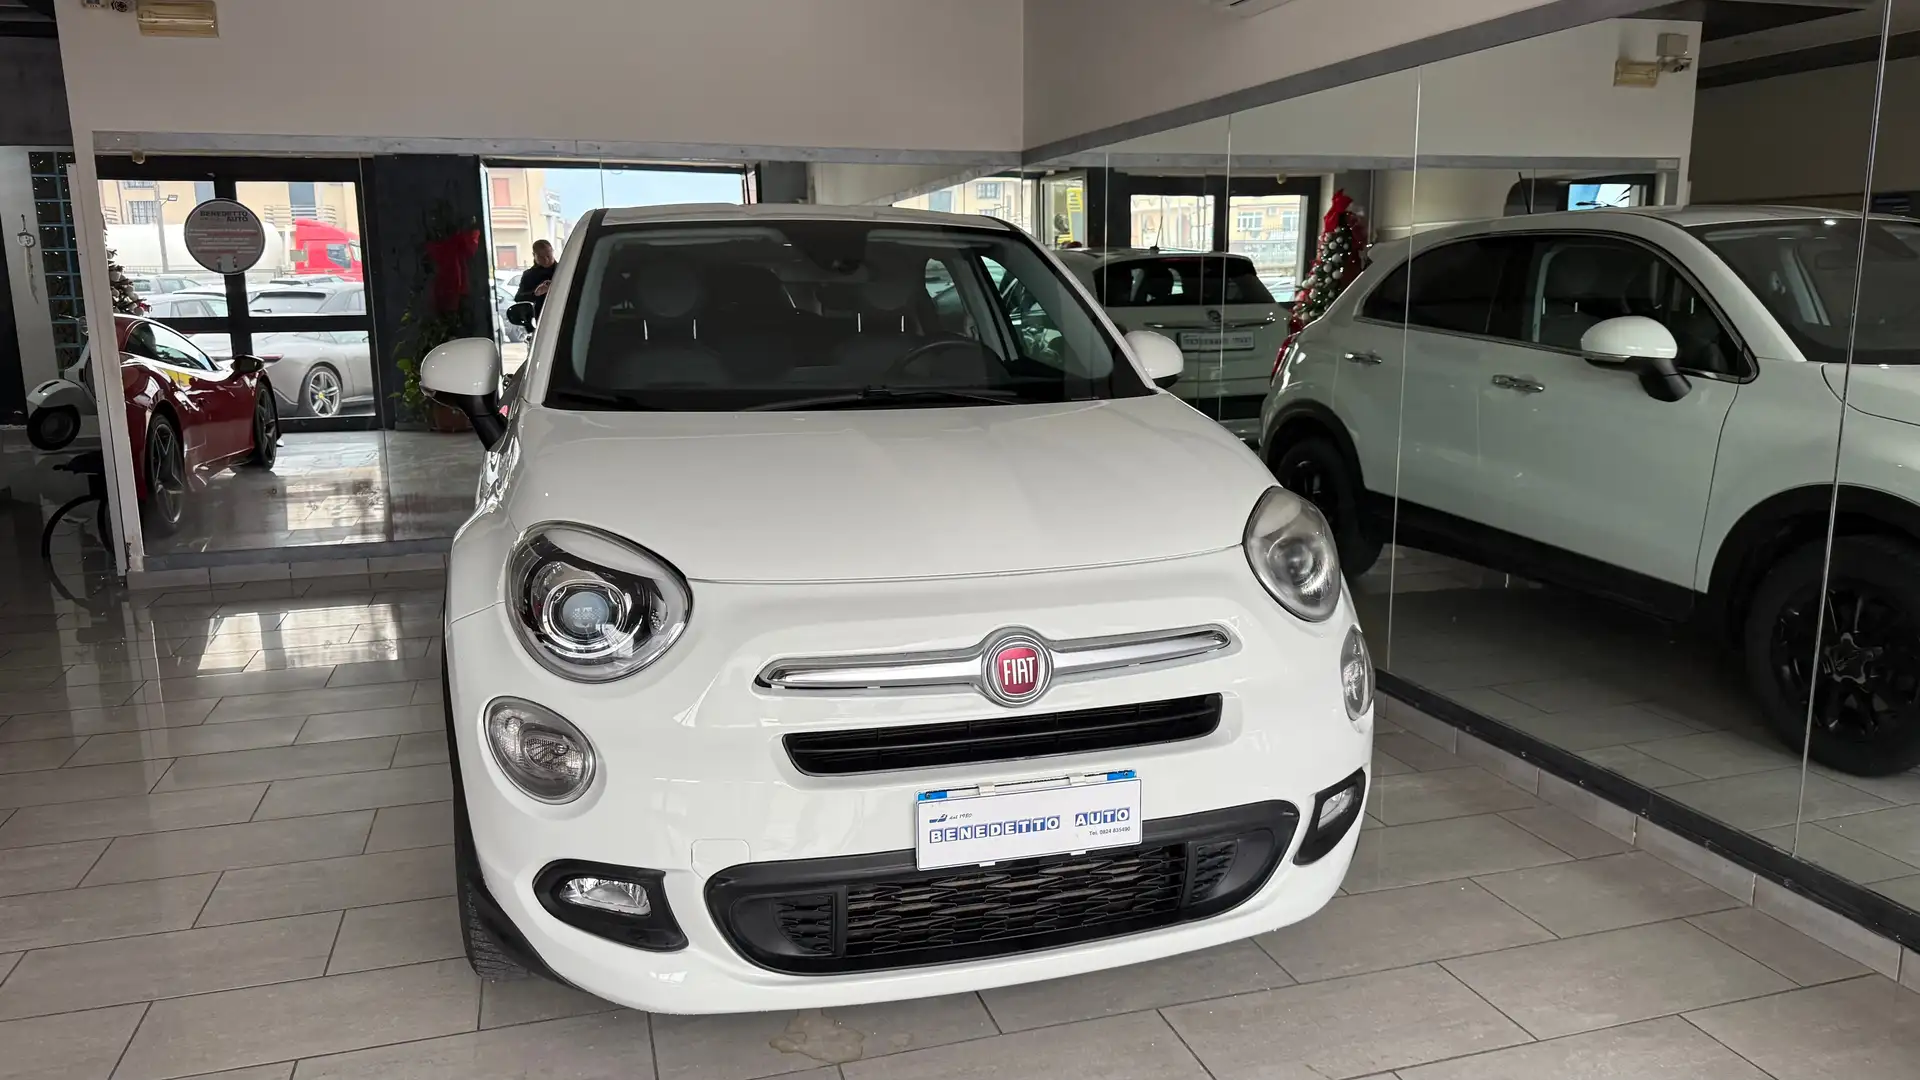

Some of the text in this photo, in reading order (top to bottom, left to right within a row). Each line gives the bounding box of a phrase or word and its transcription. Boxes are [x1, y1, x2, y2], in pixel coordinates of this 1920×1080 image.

[1003, 656, 1035, 686] FIAT
[929, 807, 1130, 844] BENEDETTO AUTO
